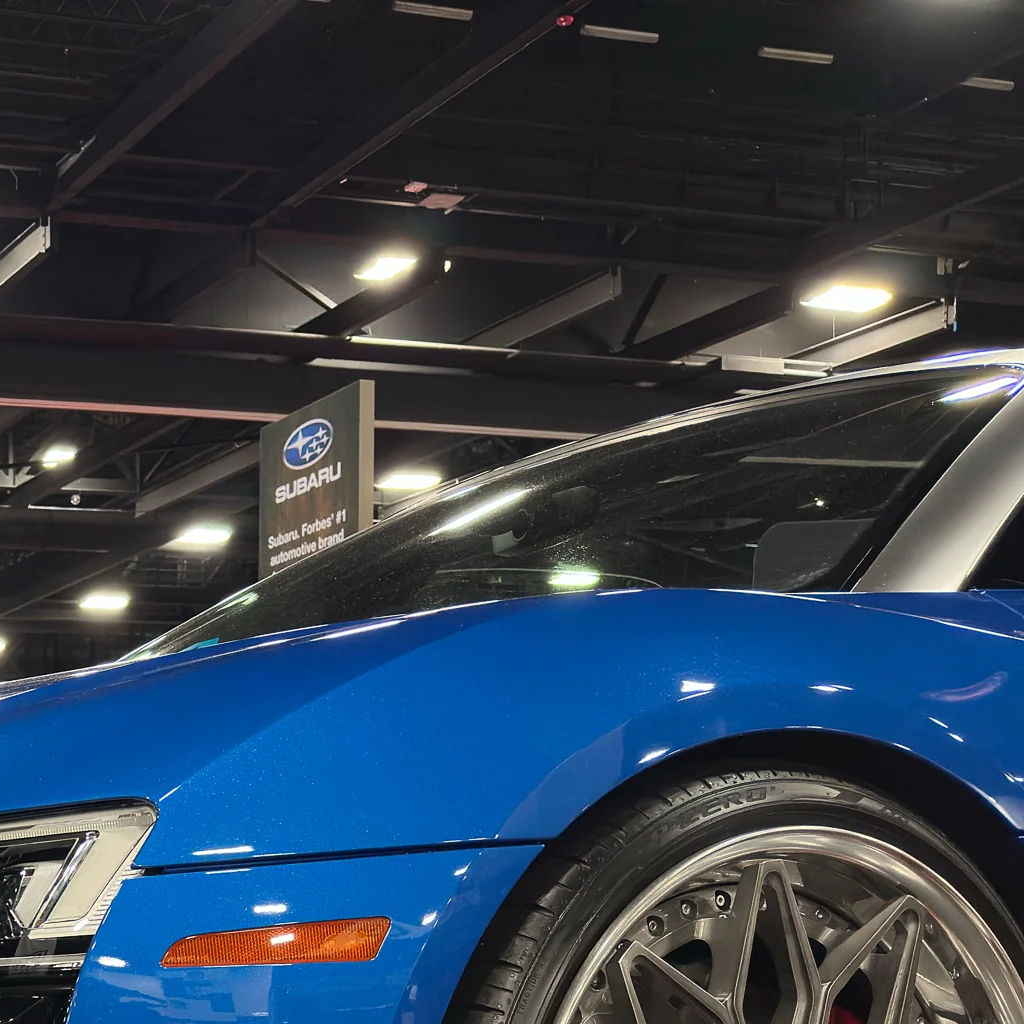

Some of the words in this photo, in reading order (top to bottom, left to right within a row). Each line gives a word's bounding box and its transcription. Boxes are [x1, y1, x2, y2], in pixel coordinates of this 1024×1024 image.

[275, 461, 342, 504] SUBARU
[268, 529, 301, 549] Subaru.
[301, 513, 335, 537] Forbes'
[336, 508, 347, 525] #1
[270, 541, 317, 567] automotive
[317, 528, 345, 550] brand
